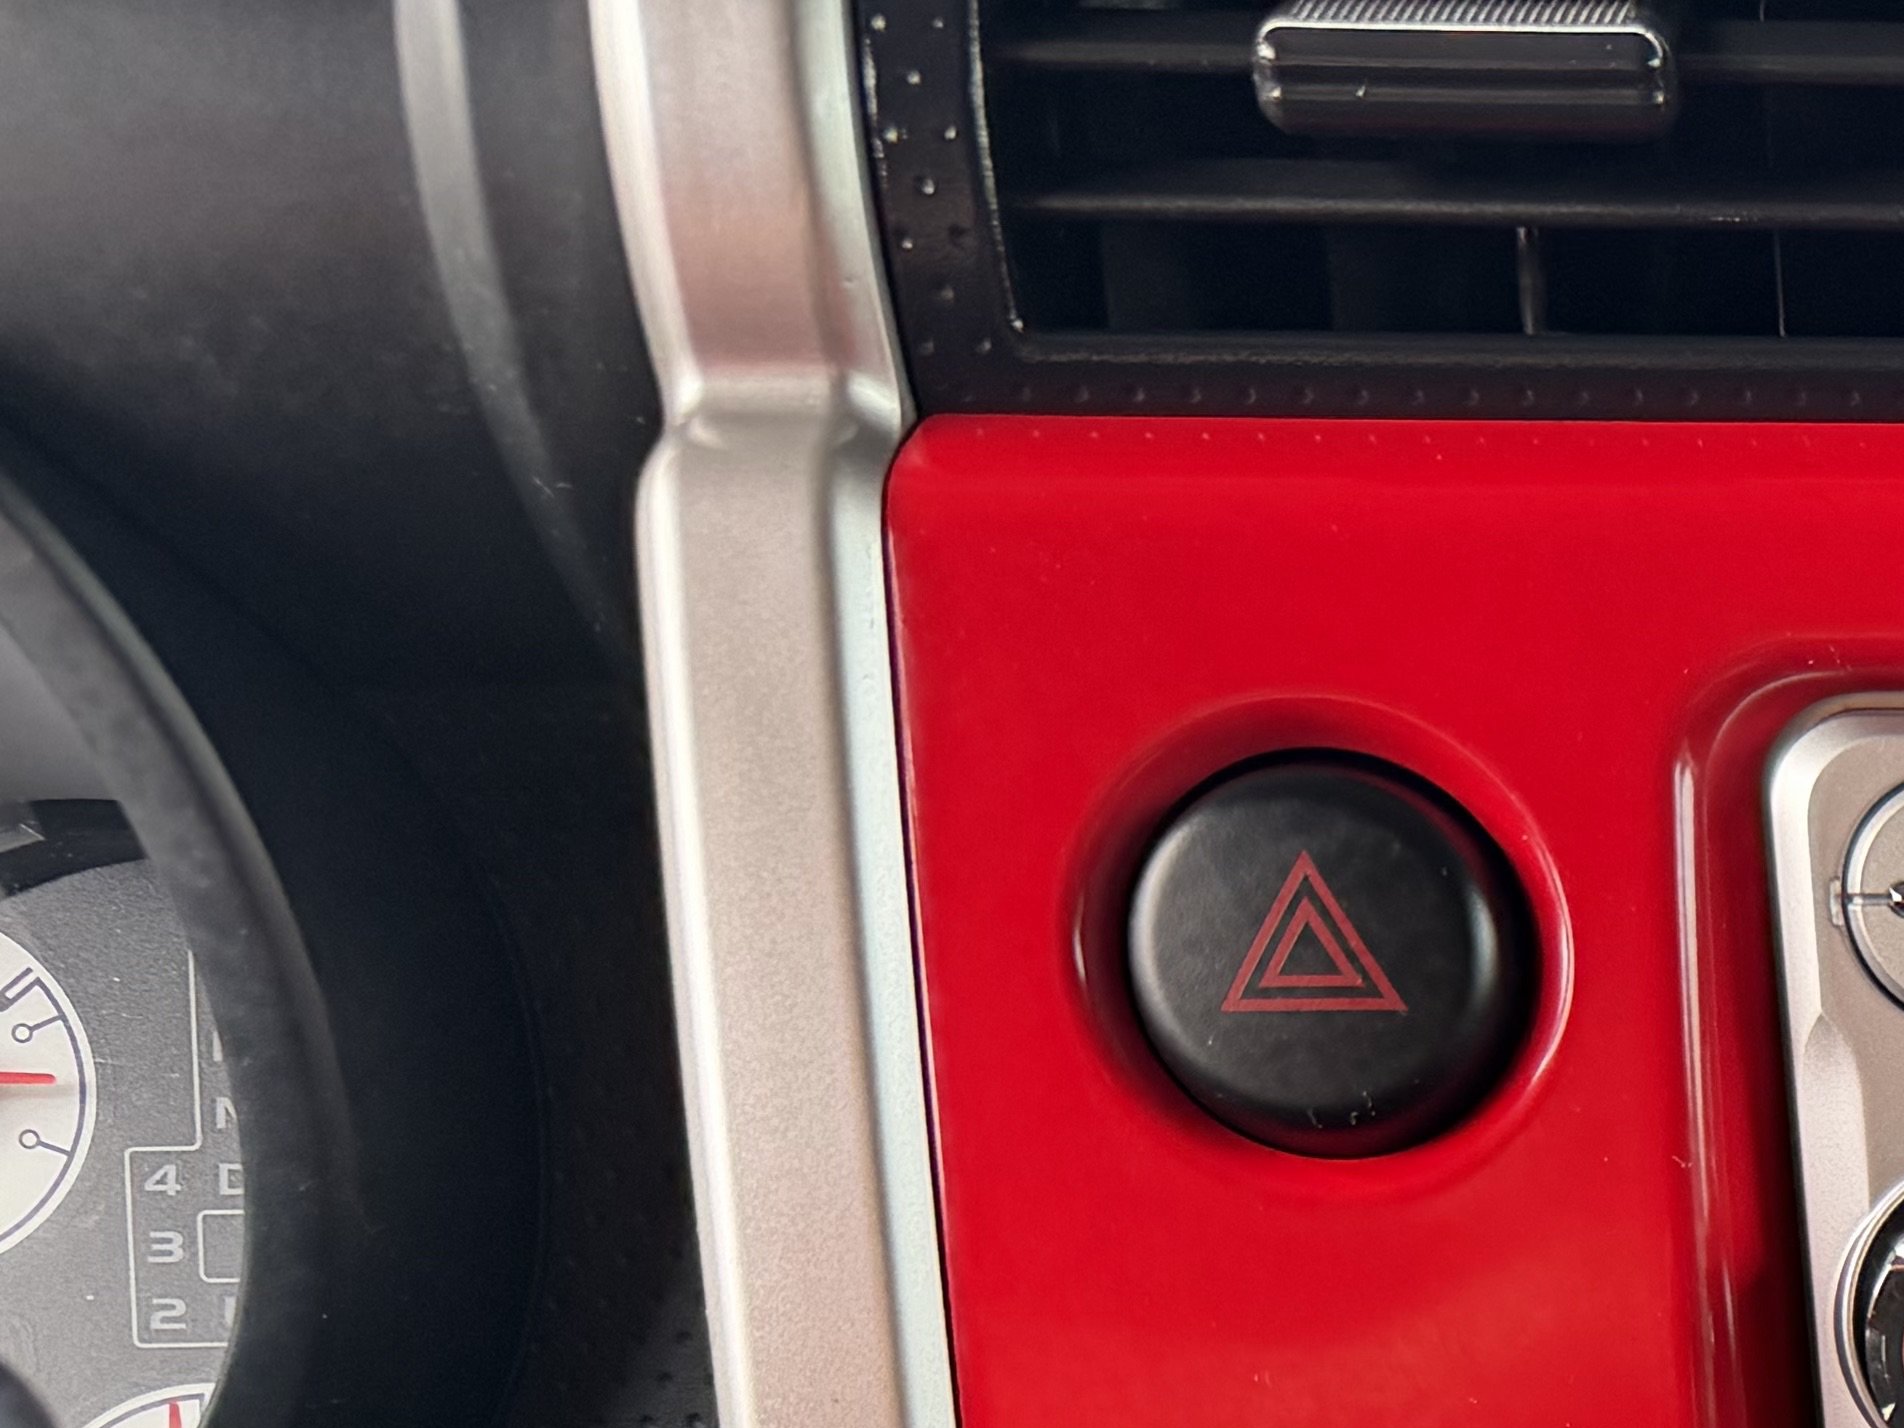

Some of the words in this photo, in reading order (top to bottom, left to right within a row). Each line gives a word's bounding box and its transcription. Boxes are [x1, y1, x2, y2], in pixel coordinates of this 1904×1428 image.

[144, 1164, 182, 1196] 4
[147, 1231, 185, 1263] 3
[150, 1297, 187, 1329] 2
